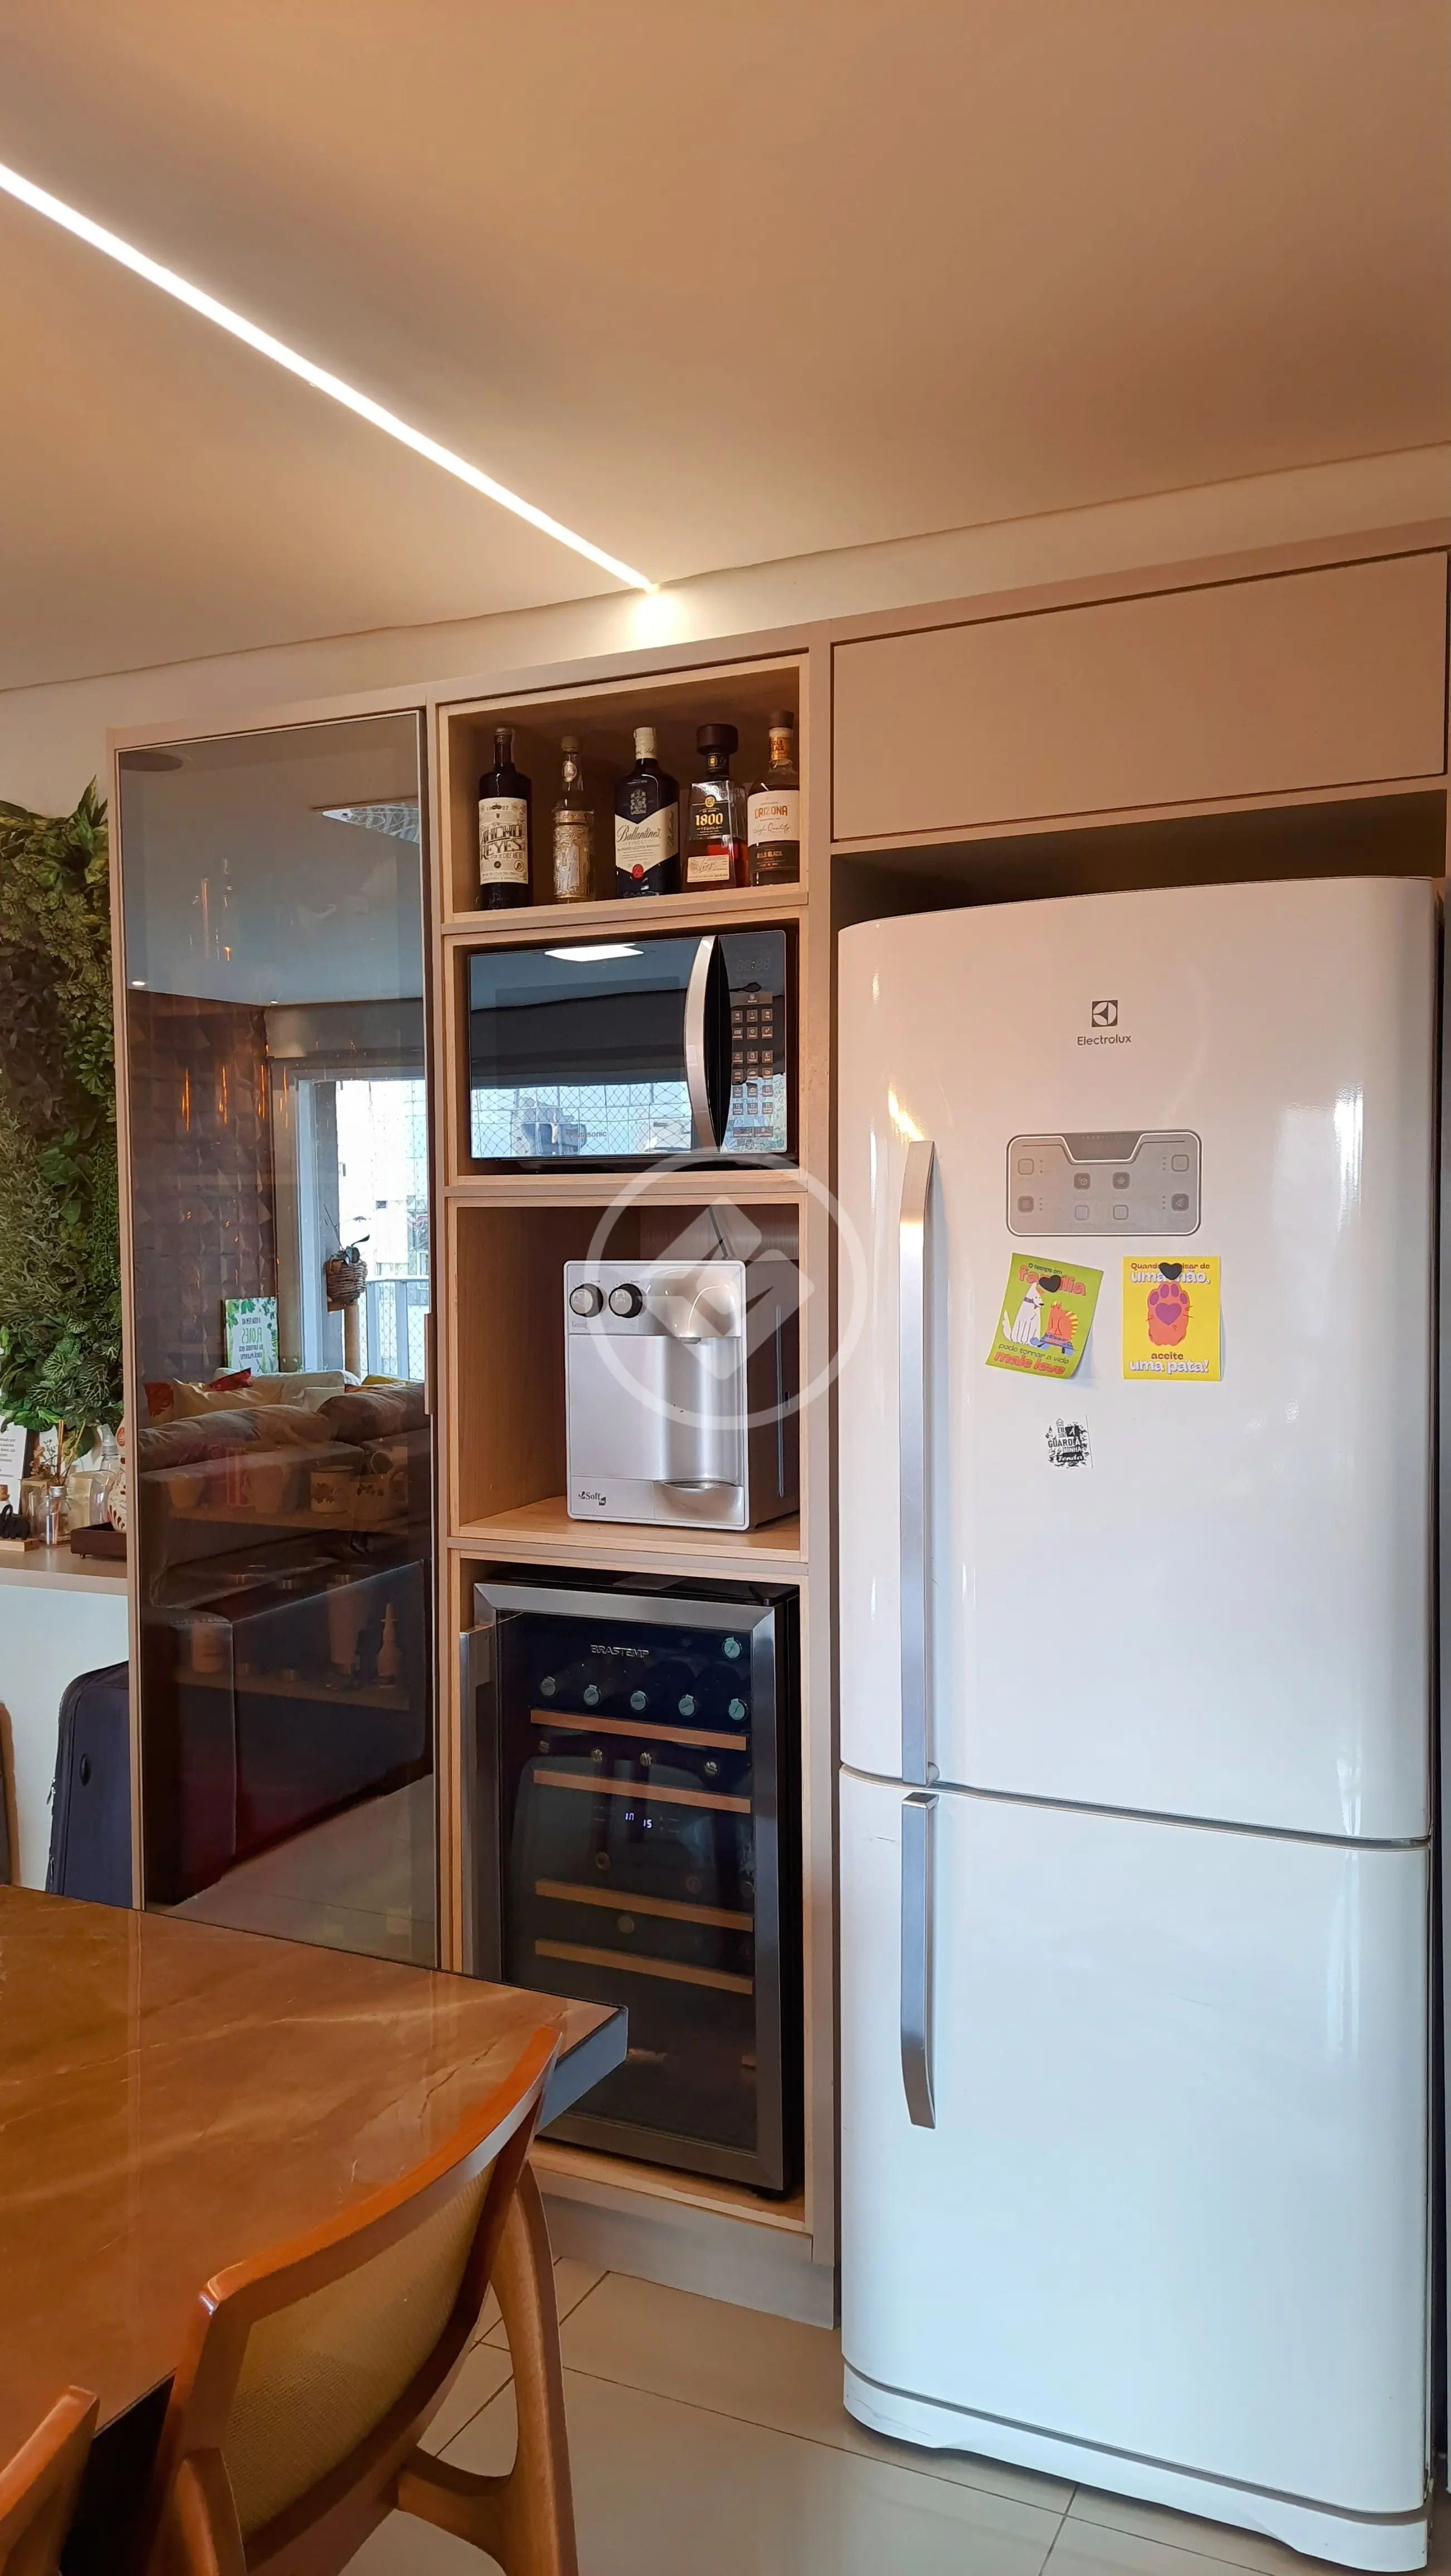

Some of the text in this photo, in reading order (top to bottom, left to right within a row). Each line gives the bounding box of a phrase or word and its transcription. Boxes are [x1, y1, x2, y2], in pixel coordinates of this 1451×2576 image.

[695, 813, 723, 826] 1800
[616, 824, 661, 842] Ballantine's
[481, 840, 524, 860] REYES
[1077, 1034, 1132, 1046] Electrolux
[1034, 1265, 1052, 1273] tempo
[1019, 1264, 1085, 1296] falia
[1131, 1271, 1166, 1283] uma
[998, 1344, 1018, 1353] pode
[1020, 1348, 1045, 1358] tornar
[1053, 1356, 1069, 1364] vida
[1151, 1352, 1184, 1360] aceite
[994, 1351, 1065, 1374] mais love
[1129, 1359, 1209, 1374] uma pata!
[591, 1645, 649, 1658] BRASTEMP
[643, 1819, 653, 1828] 15
